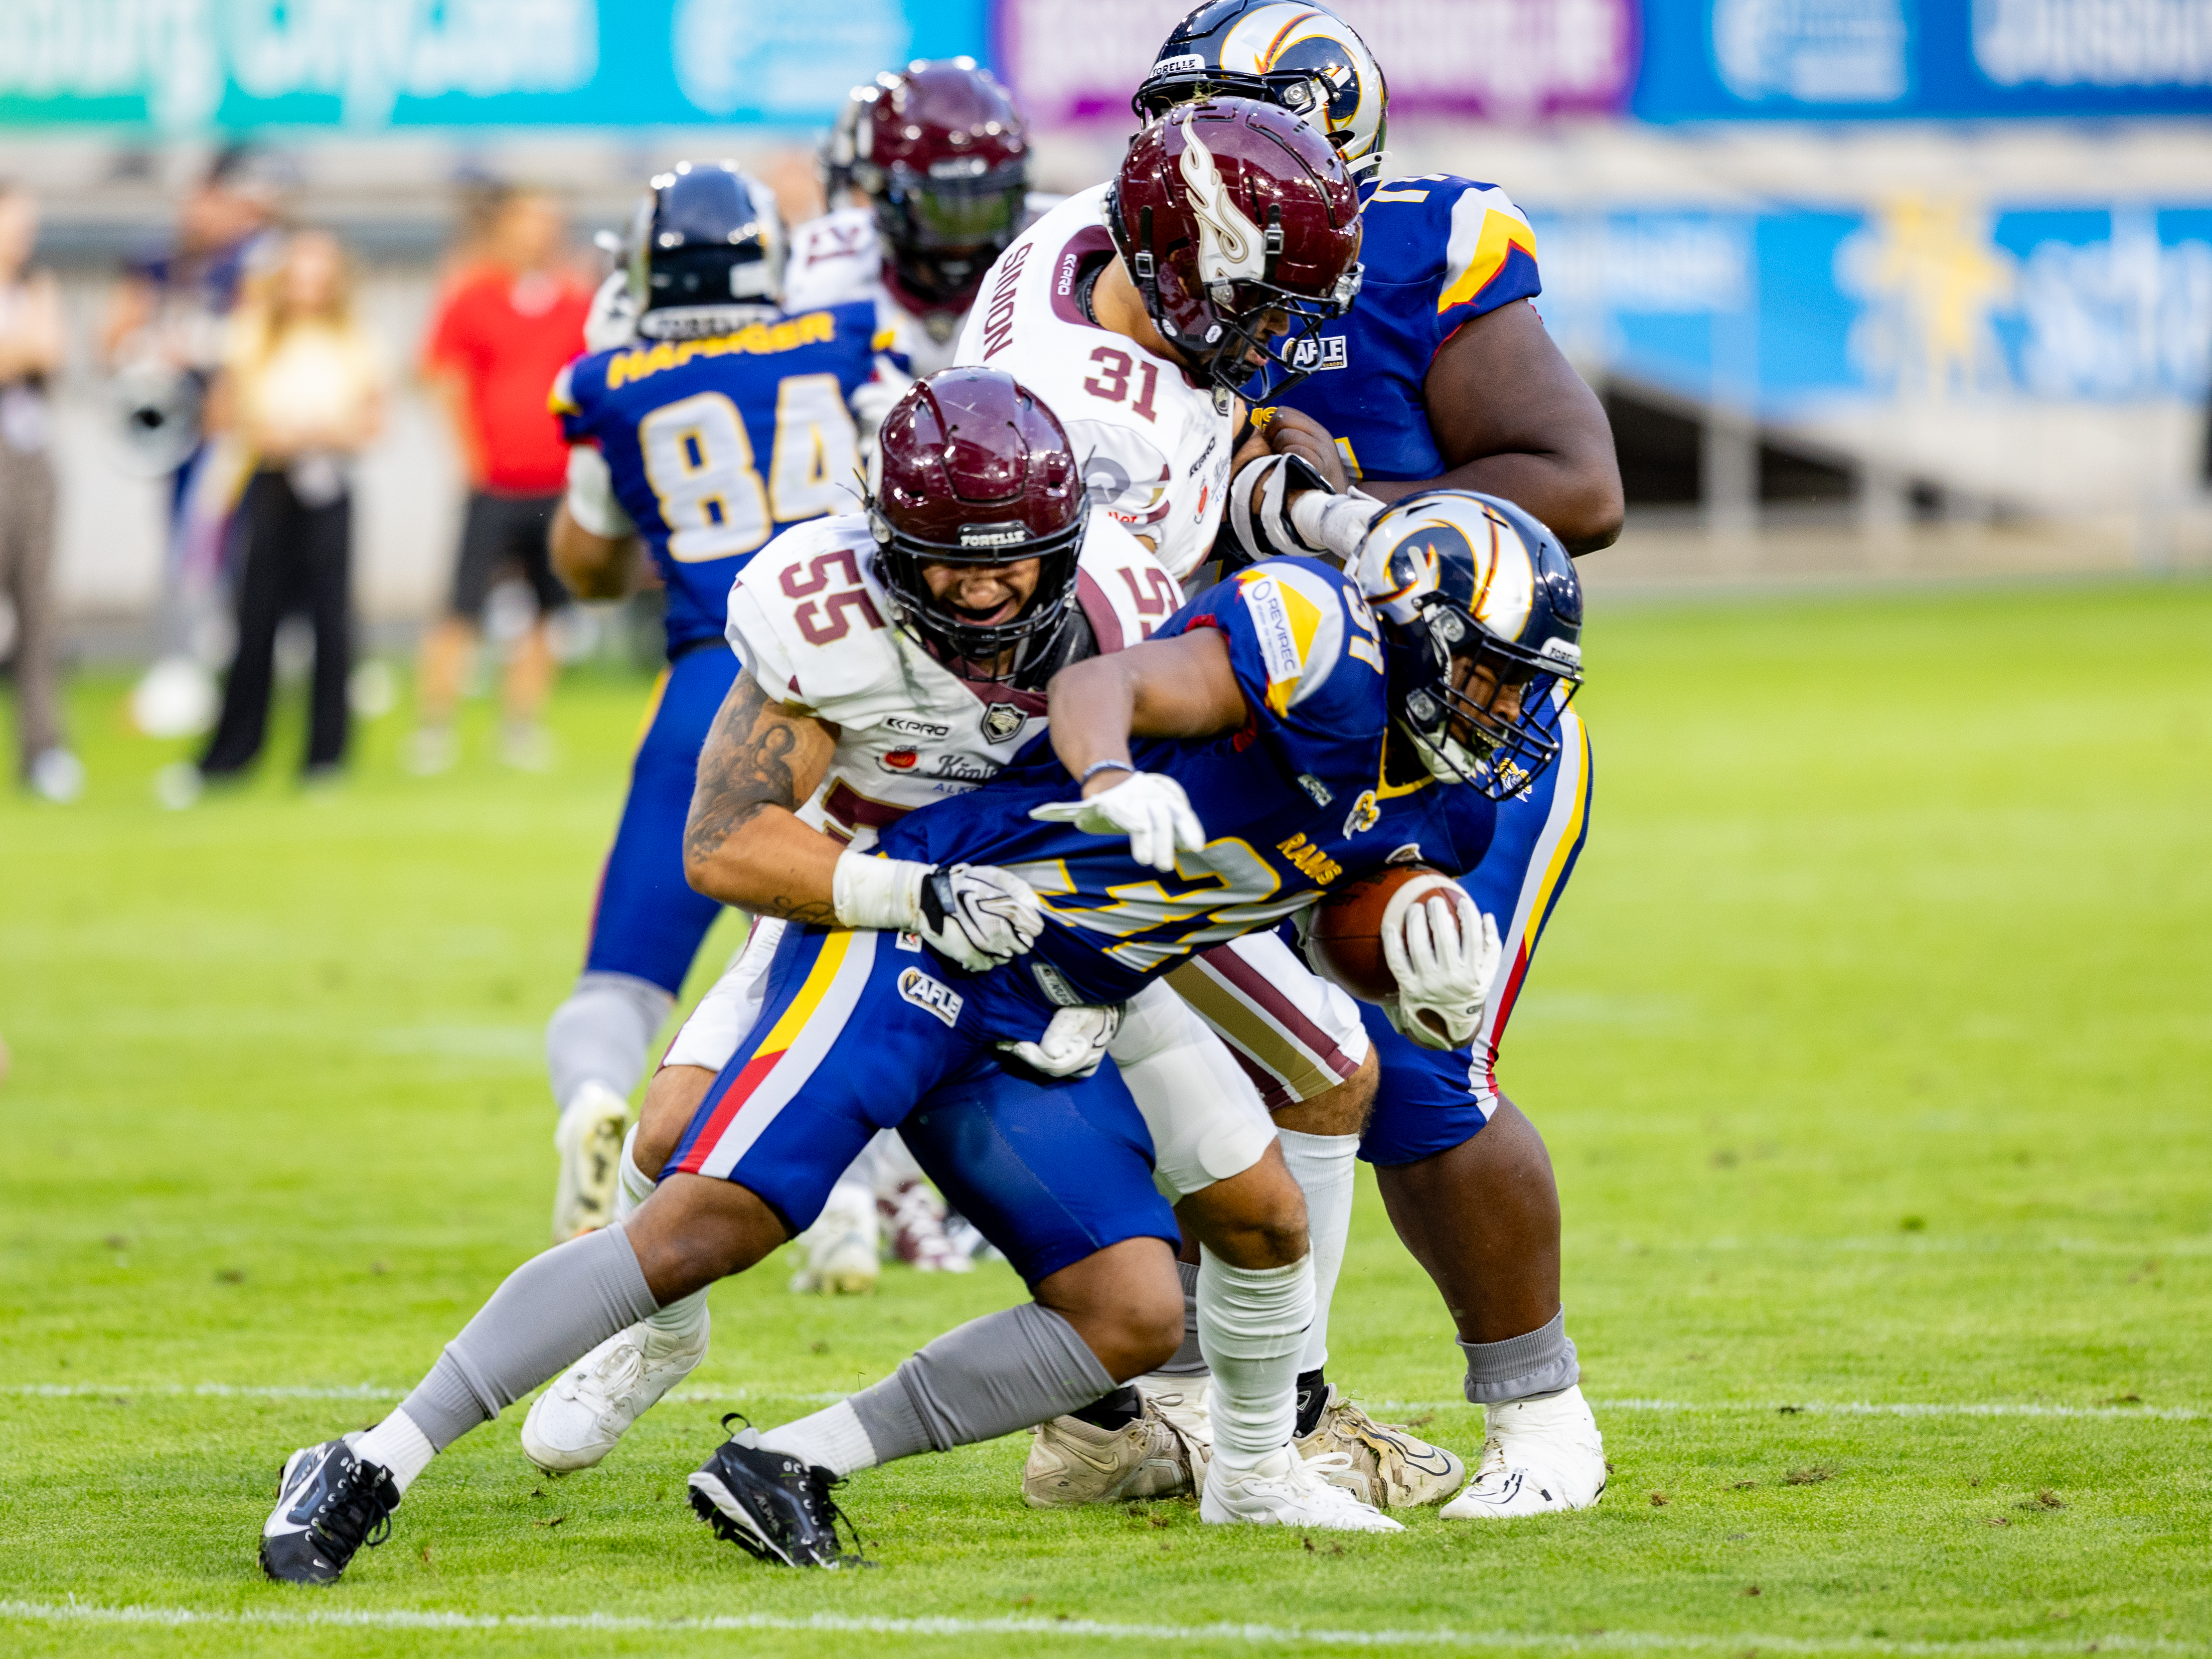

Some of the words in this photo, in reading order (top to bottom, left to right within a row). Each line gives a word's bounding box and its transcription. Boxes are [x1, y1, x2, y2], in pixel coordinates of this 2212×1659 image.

[983, 242, 1034, 362] SIMON
[1083, 346, 1159, 424] 31
[638, 372, 868, 563] 84
[778, 549, 887, 647] 55
[1267, 597, 1301, 672] REVIREC
[1276, 832, 1343, 885] RAMS
[907, 978, 959, 1019] AFLE
